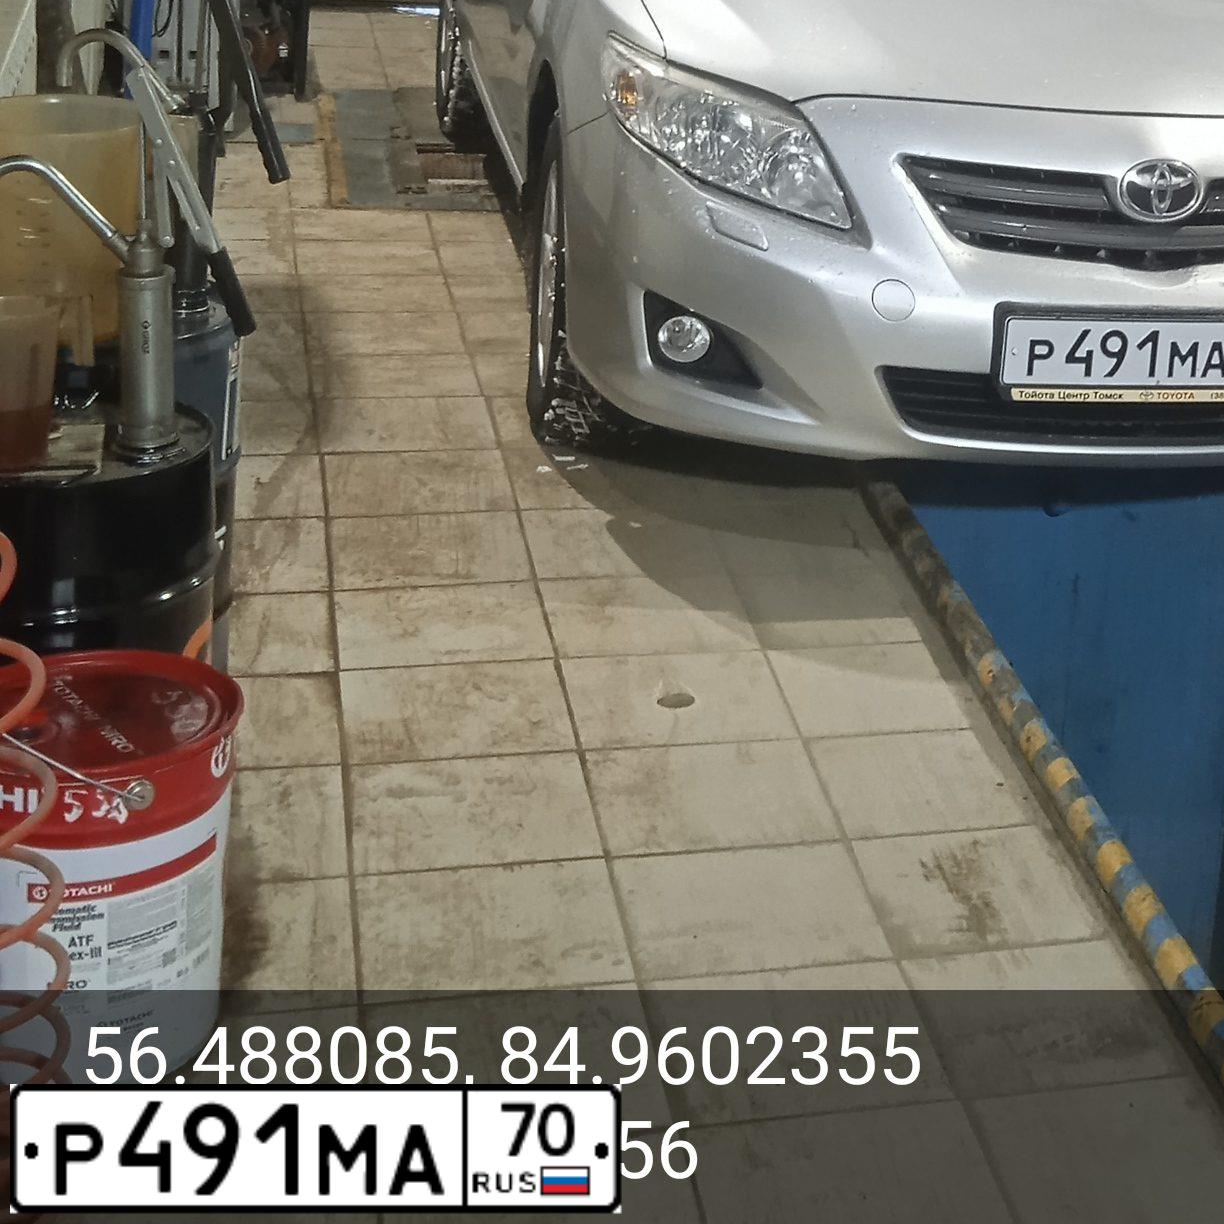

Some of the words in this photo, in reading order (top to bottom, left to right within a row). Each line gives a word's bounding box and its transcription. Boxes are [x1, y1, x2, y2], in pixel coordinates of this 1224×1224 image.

[1018, 389, 1055, 400] Тойота
[1057, 390, 1091, 402] Центр
[1093, 391, 1124, 401] Томск
[1156, 391, 1196, 400] TOYOTA
[63, 883, 113, 898] OTACHI
[67, 935, 95, 948] ATF
